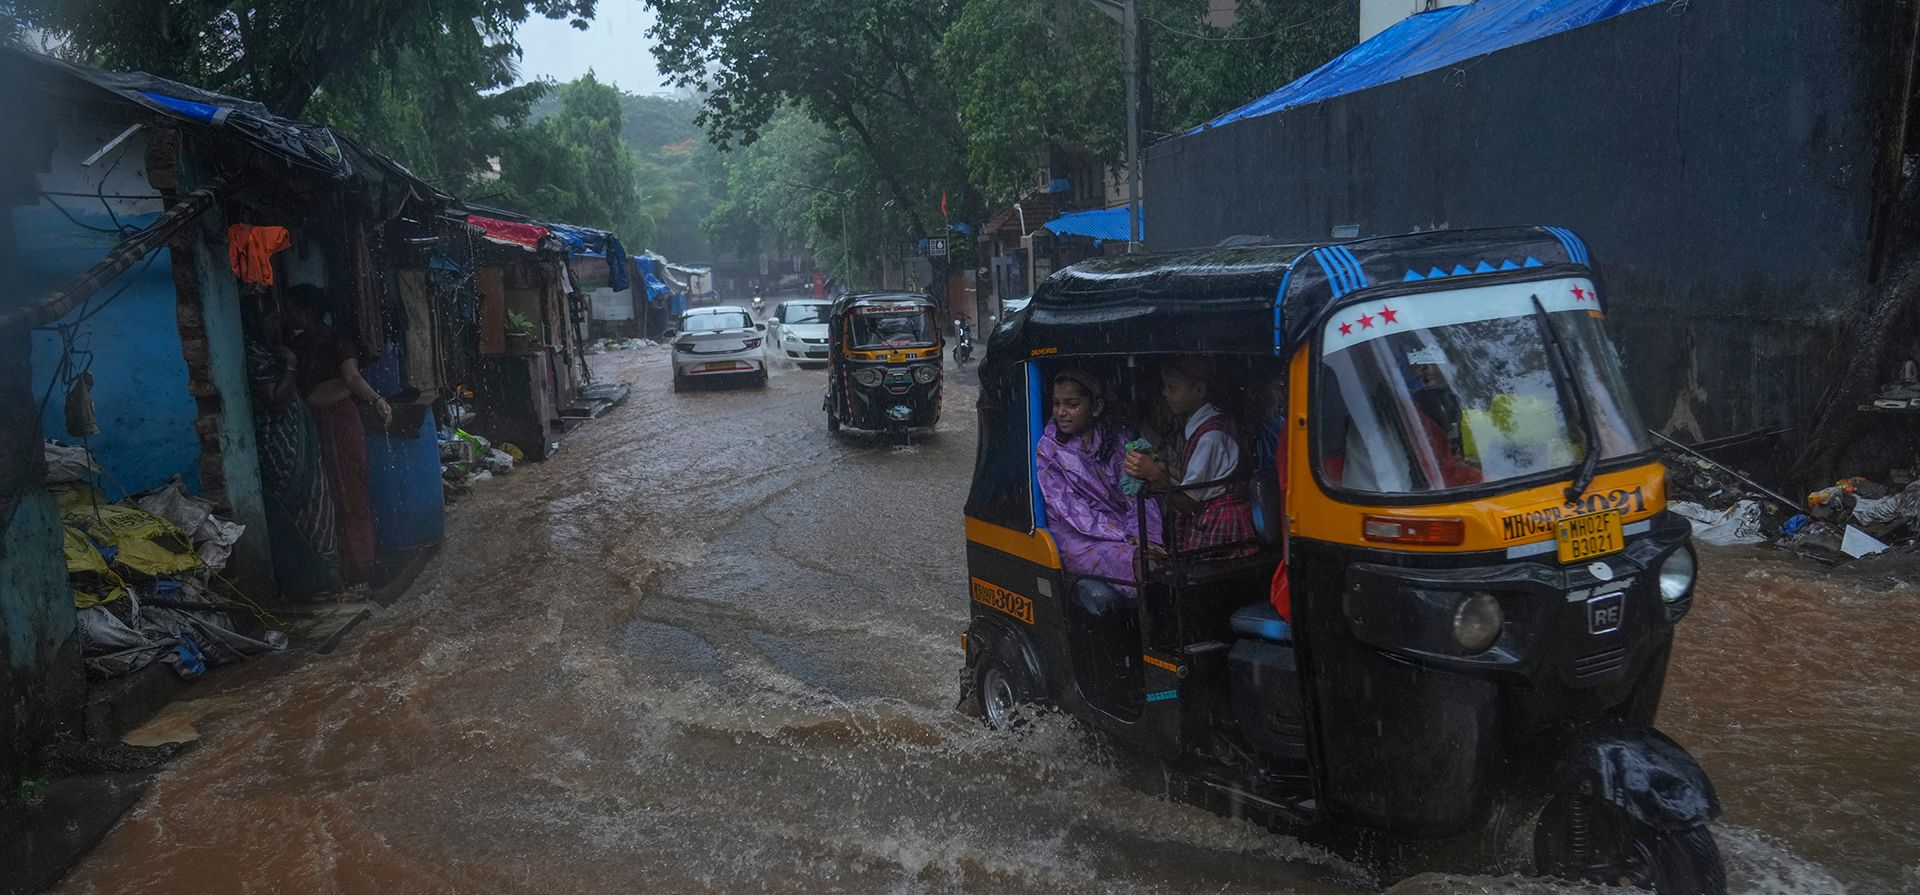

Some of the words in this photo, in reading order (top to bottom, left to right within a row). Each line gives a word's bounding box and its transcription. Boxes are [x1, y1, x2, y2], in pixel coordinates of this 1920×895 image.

[1570, 514, 1610, 538] MH02F
[1572, 533, 1613, 558] B3021
[995, 589, 1033, 623] 3021
[1594, 605, 1619, 627] RE
